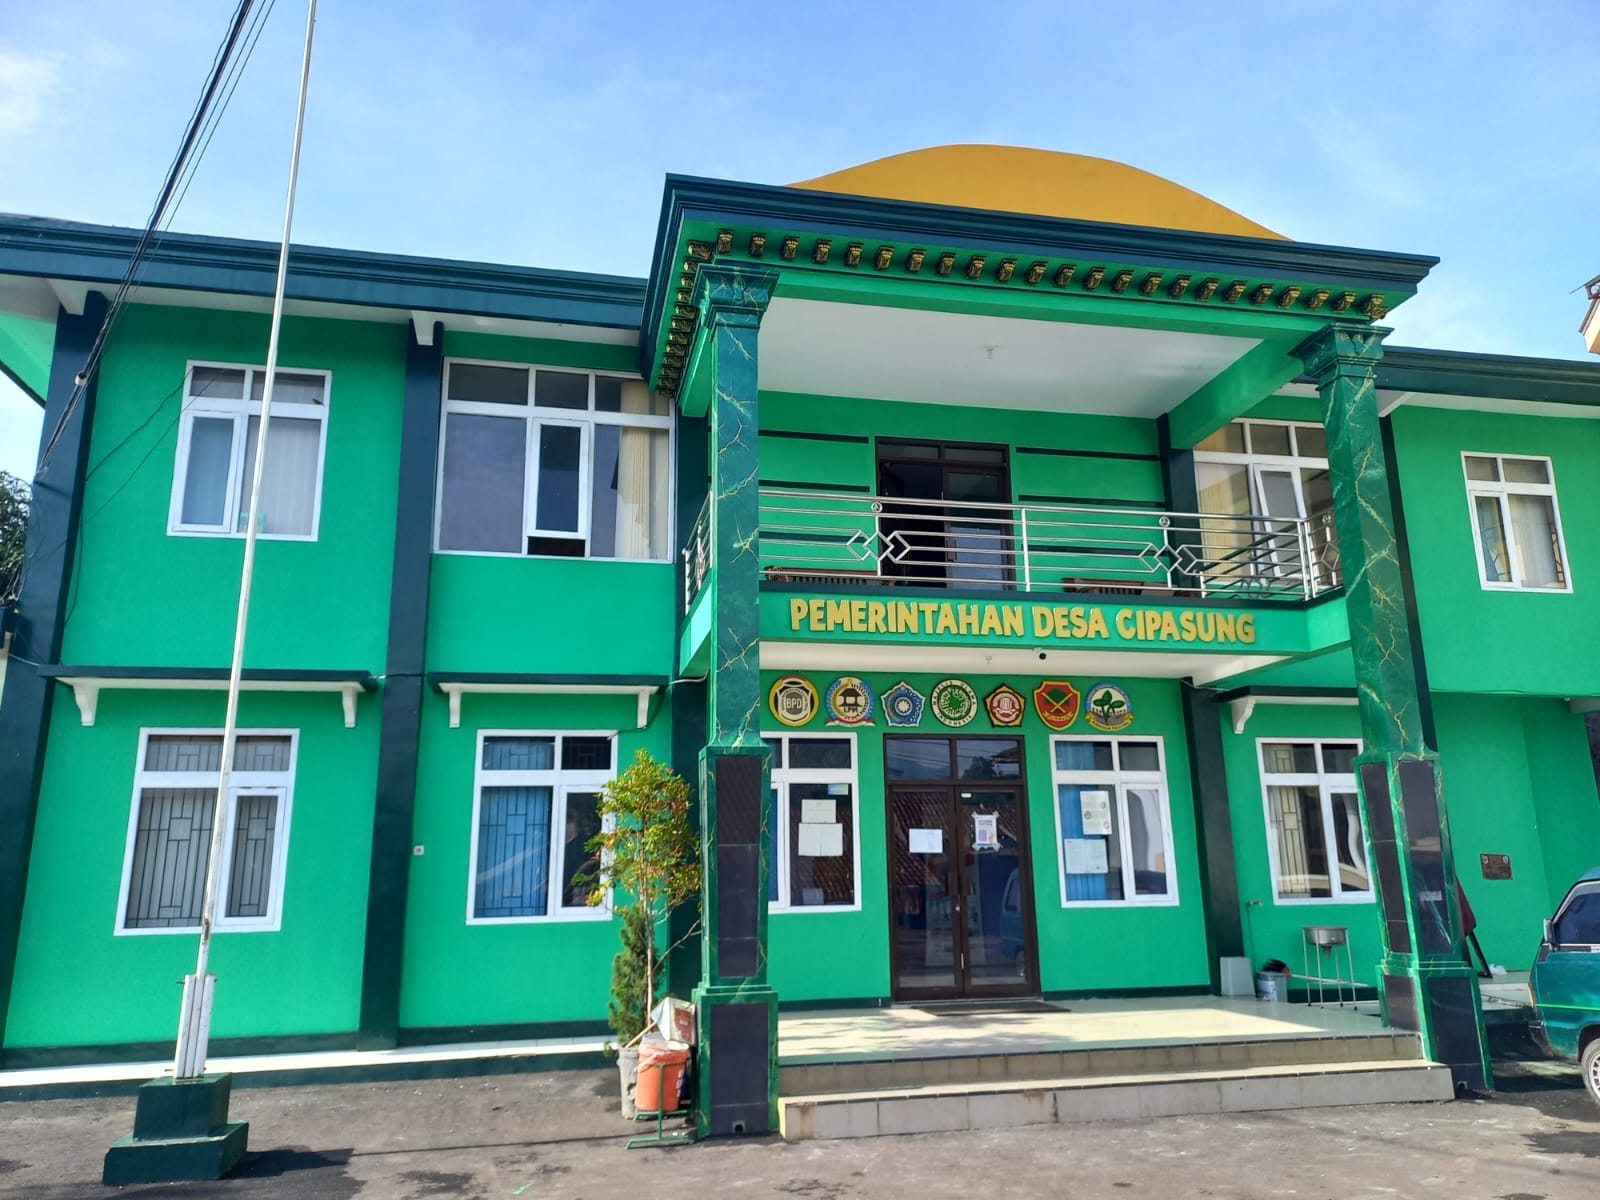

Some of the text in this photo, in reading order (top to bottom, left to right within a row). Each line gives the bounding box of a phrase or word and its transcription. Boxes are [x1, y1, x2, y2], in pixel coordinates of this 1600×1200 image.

[790, 598, 1256, 644] PEMERINTAHAN DESA CIPASUNG
[786, 697, 802, 709] BPD
